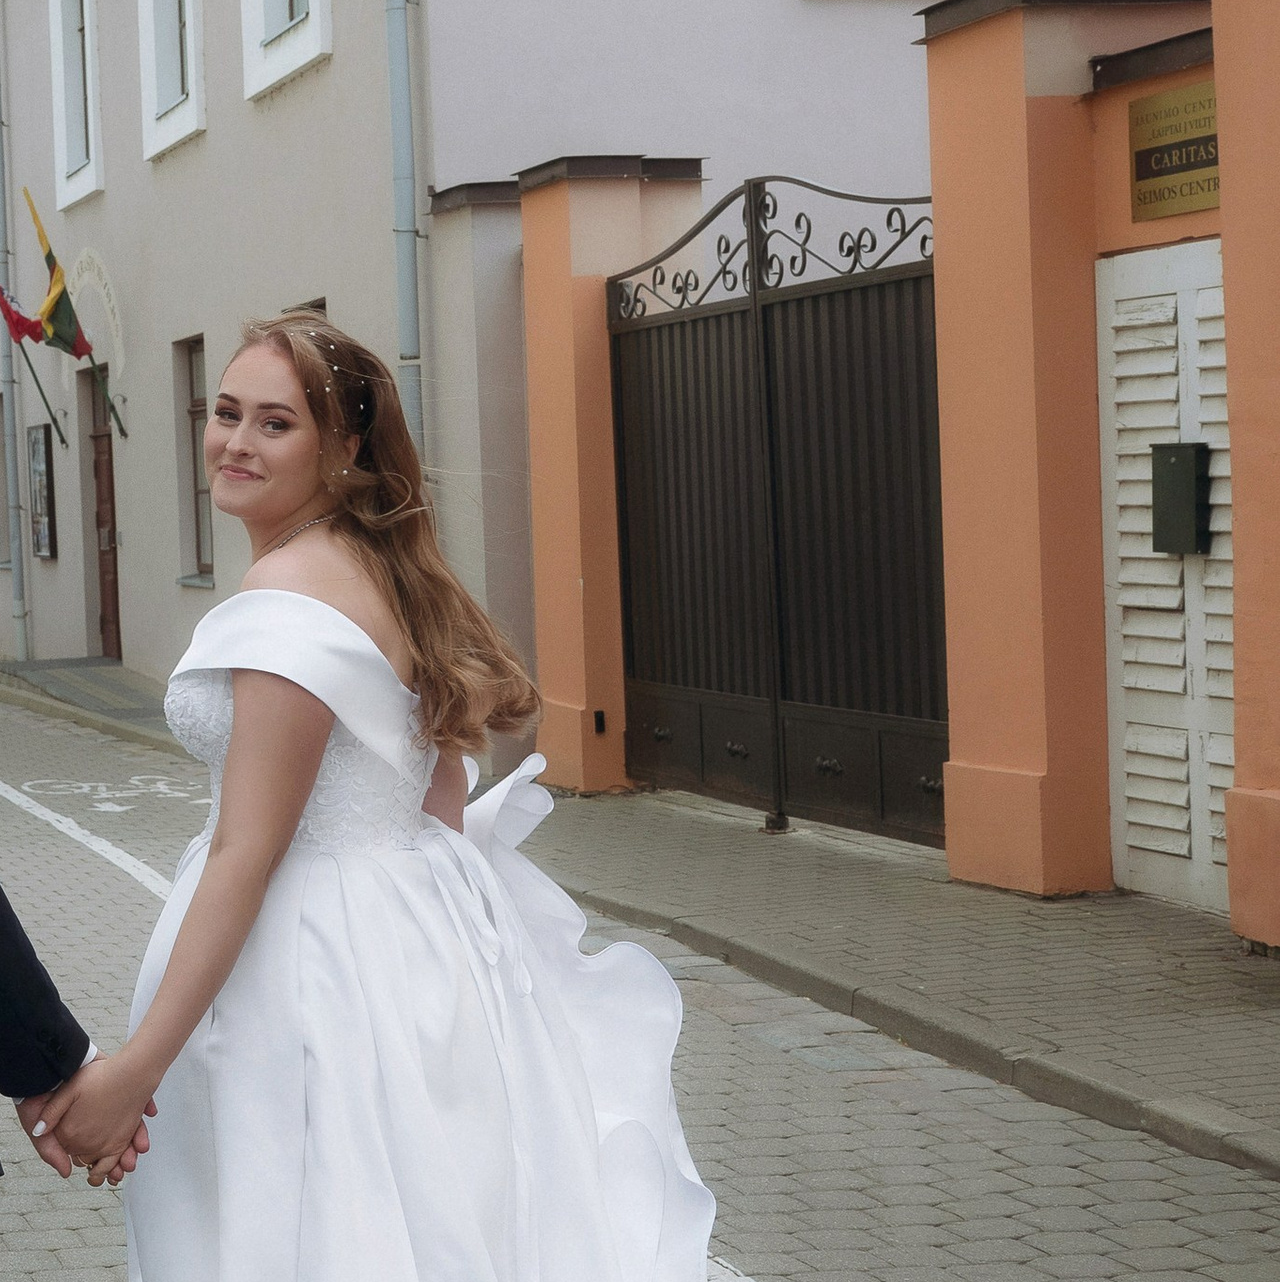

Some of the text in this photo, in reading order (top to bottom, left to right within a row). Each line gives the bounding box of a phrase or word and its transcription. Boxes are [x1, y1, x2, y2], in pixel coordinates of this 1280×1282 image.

[1135, 105, 1180, 127] JAUNIMO
[1151, 141, 1216, 171] CARITAS
[1137, 184, 1178, 208] ŠEIMOS
